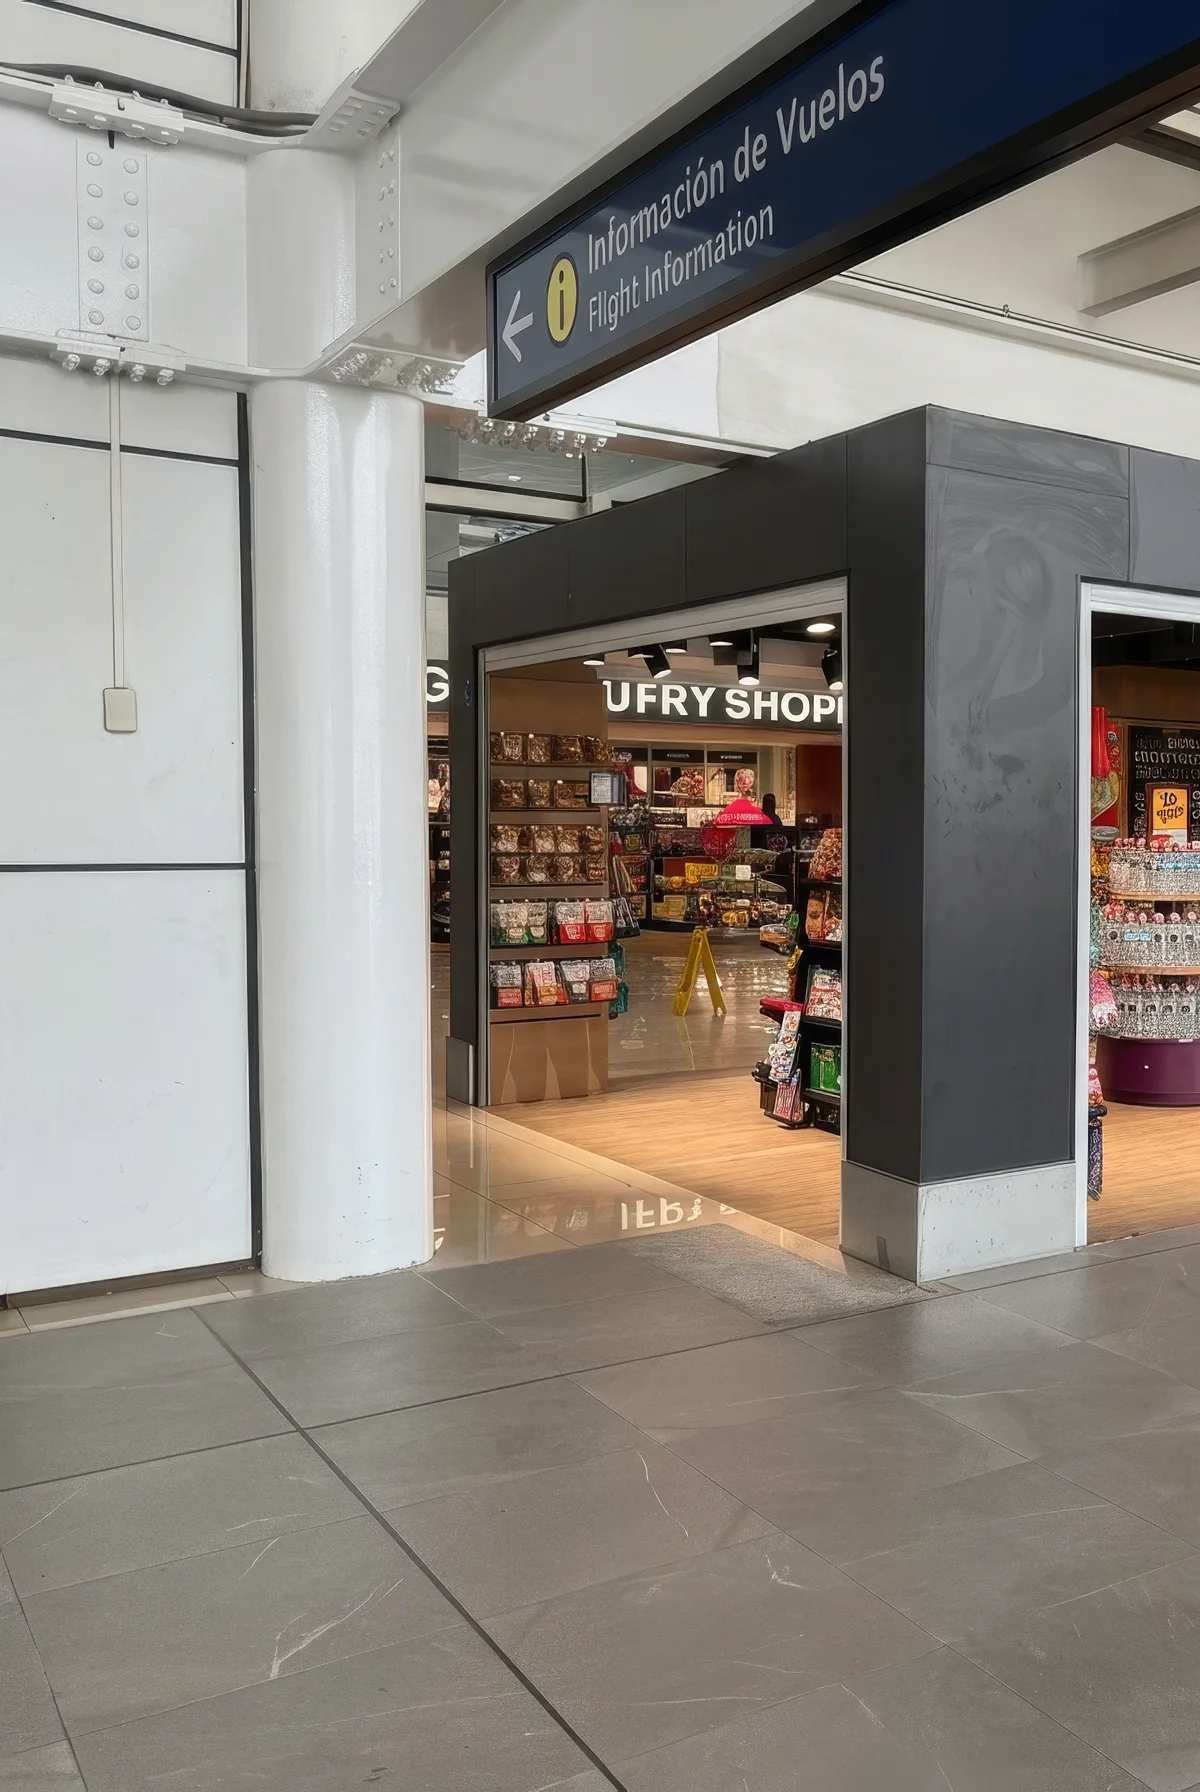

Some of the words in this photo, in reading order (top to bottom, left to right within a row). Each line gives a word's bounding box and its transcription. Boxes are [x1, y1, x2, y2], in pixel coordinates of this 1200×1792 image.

[588, 157, 724, 274] Información
[734, 126, 767, 183] de
[776, 56, 886, 154] Vuelos
[588, 276, 640, 332] Flight
[645, 205, 774, 302] Information
[602, 680, 717, 718] UFRY
